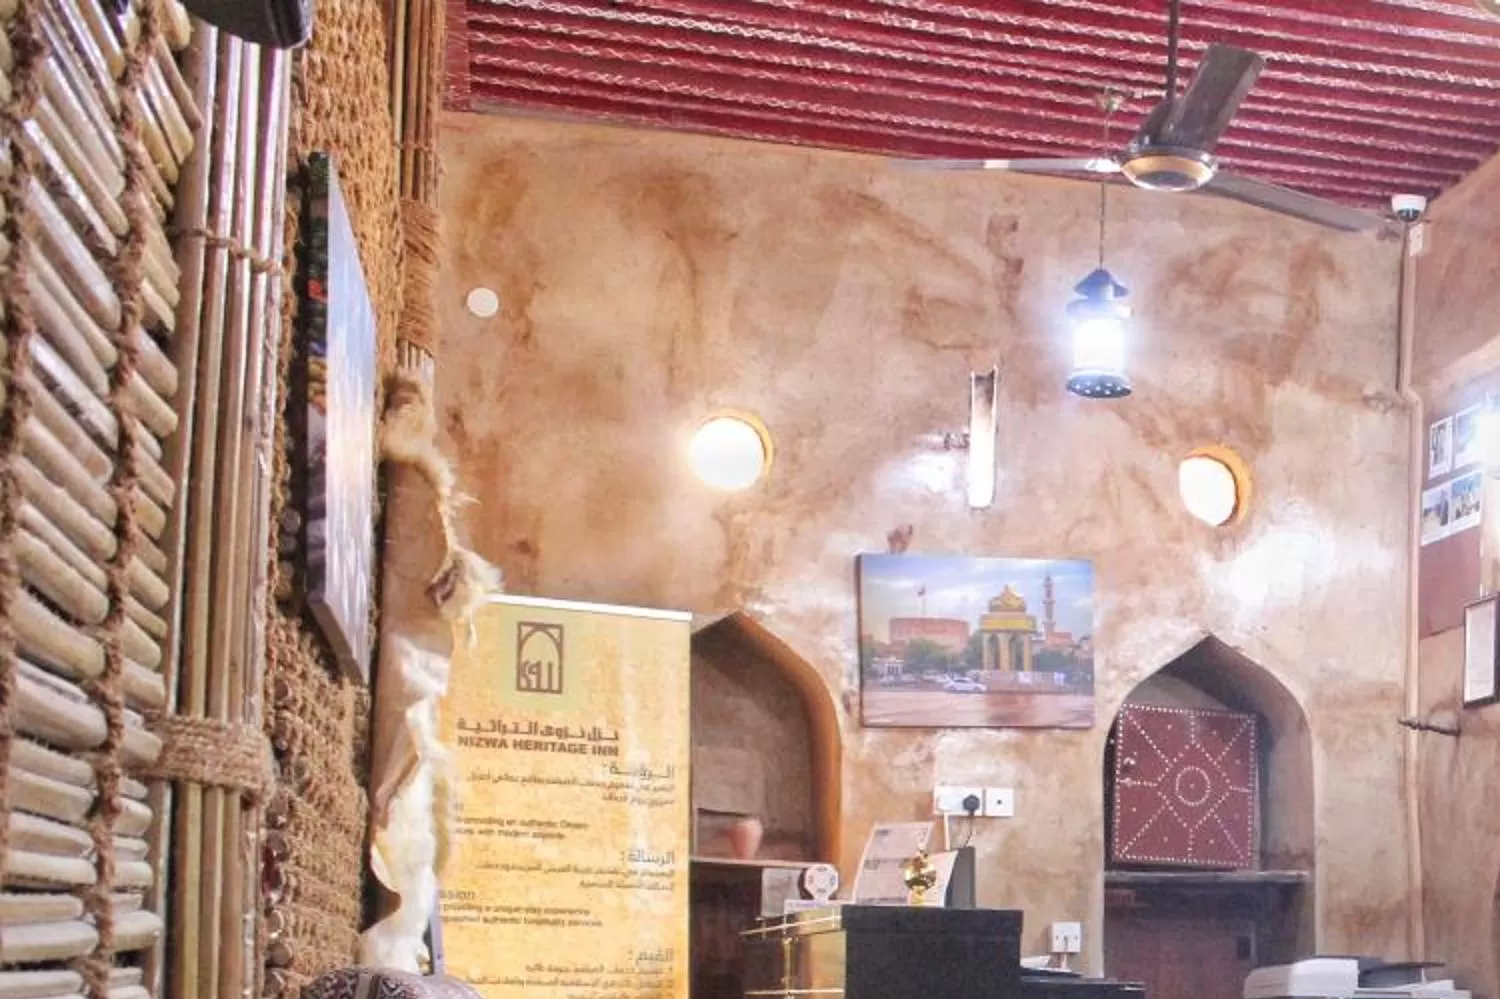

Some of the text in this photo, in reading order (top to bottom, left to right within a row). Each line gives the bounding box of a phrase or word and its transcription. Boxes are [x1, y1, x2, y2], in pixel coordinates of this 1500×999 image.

[457, 734, 620, 758] NIZWA HERITAGE INN
